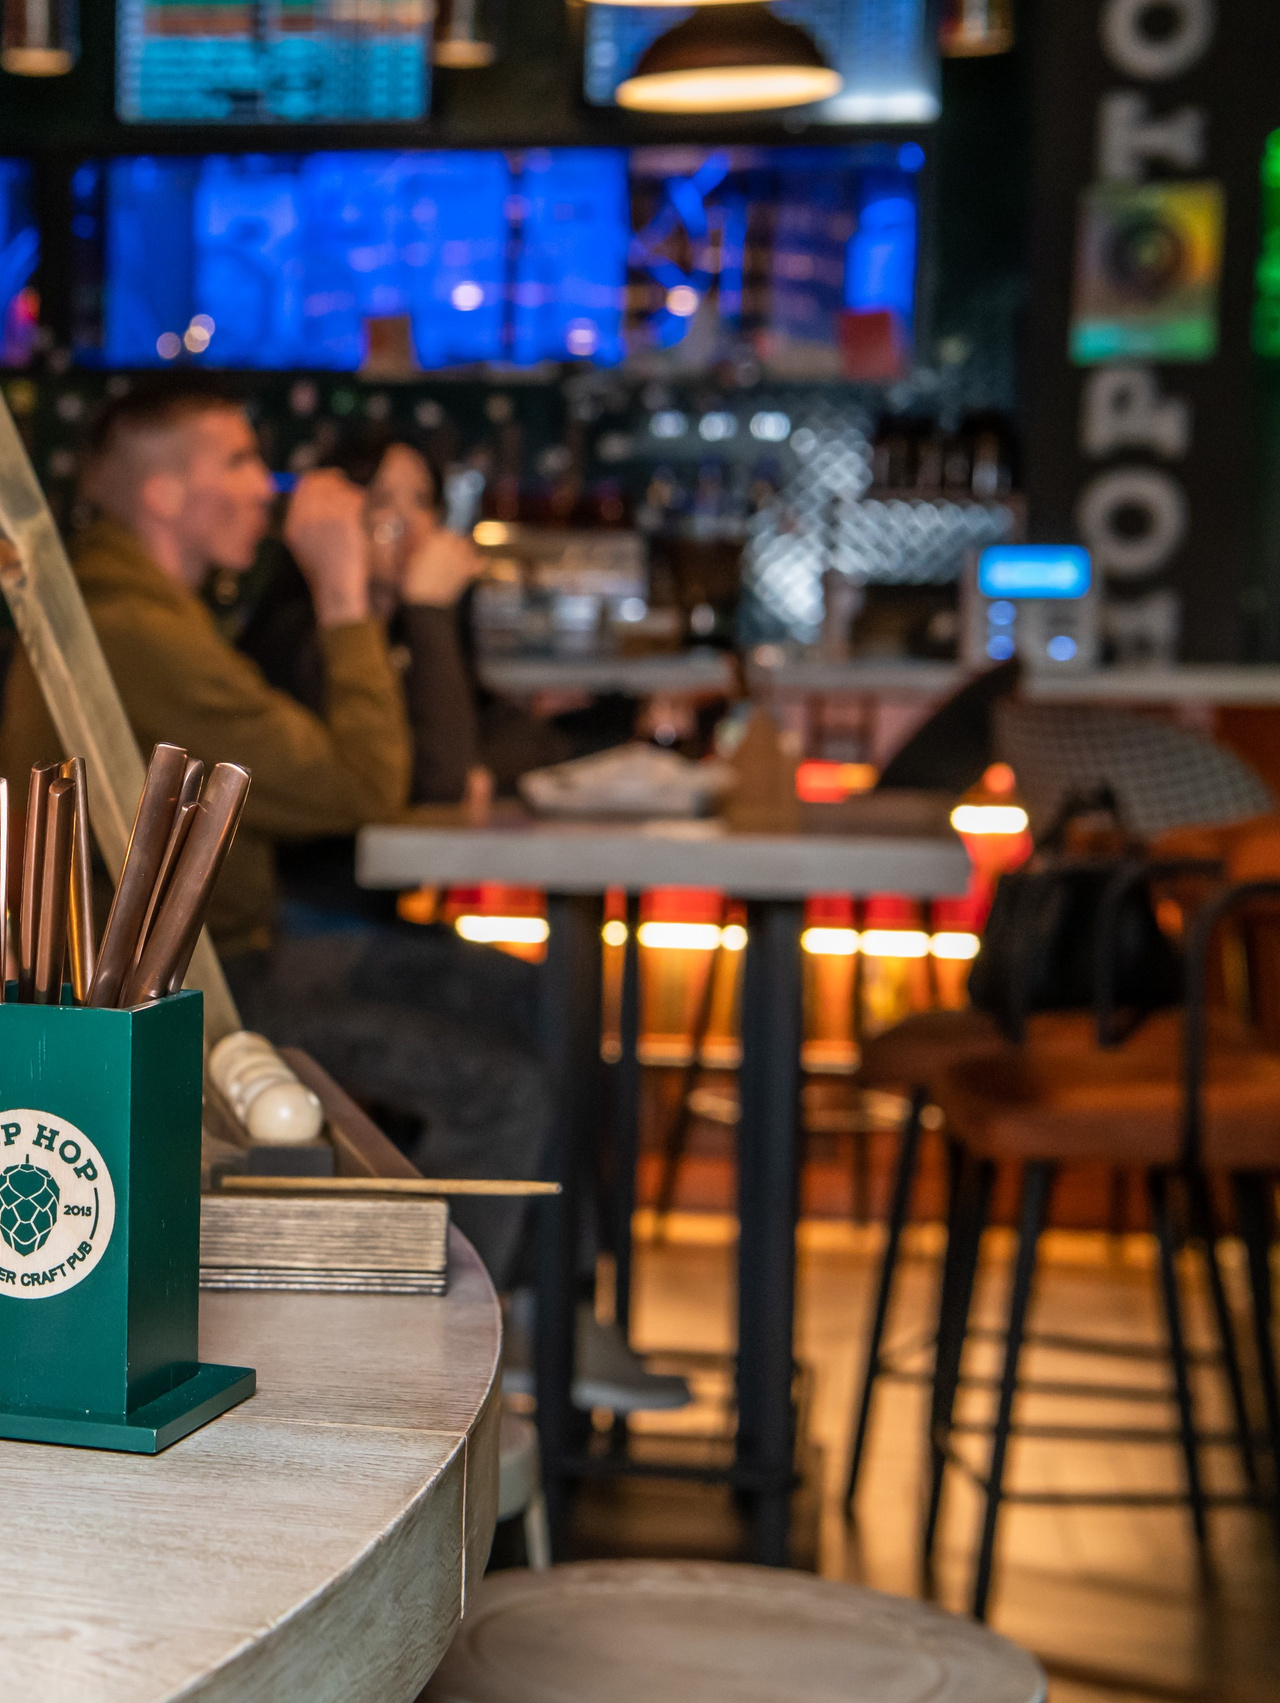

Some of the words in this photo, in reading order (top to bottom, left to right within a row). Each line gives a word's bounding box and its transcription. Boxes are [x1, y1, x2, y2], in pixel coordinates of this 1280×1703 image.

[32, 1123, 98, 1182] HOP
[63, 1204, 92, 1217] 2015
[20, 1263, 67, 1287] CRAFT
[66, 1240, 93, 1270] PUB
